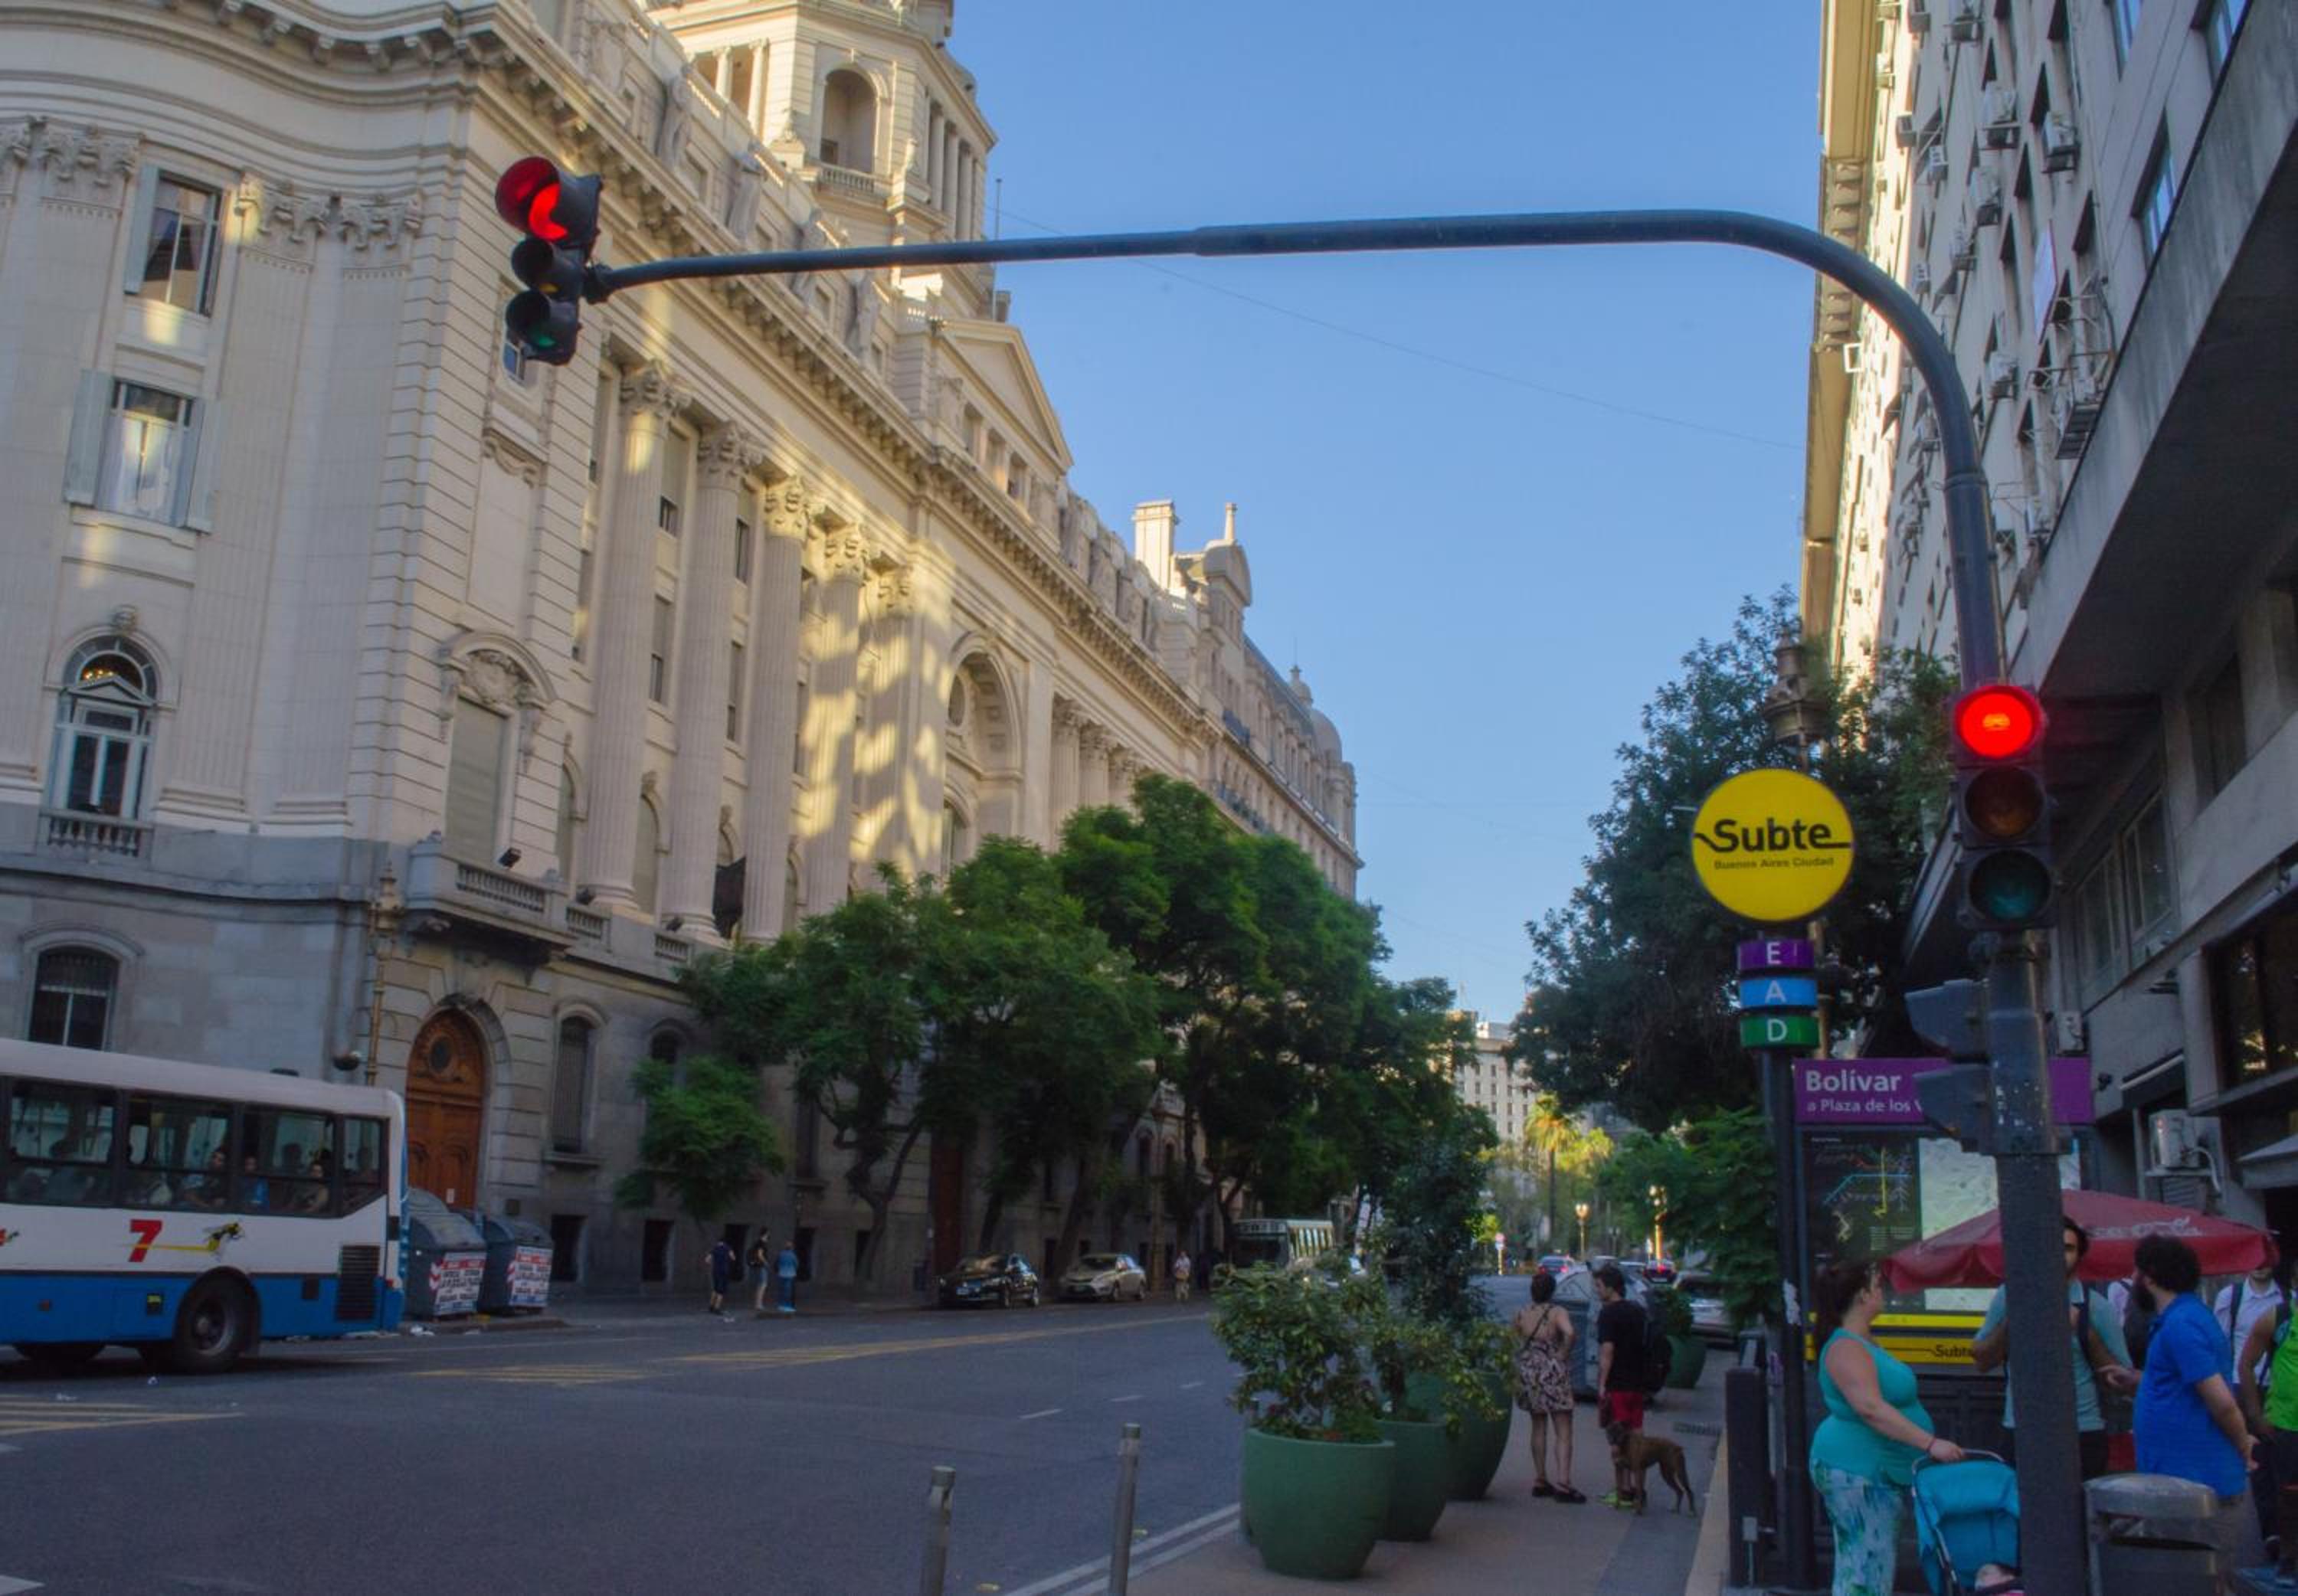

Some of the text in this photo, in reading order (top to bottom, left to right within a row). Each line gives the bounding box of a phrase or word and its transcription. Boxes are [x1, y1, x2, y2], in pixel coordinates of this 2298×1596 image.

[1708, 817, 1835, 853] Subte
[1714, 856, 1835, 870] Buenos Aires Ciudad
[1766, 941, 1782, 965] E
[1764, 980, 1787, 1004] A
[1767, 1018, 1789, 1042] D
[1805, 1069, 1903, 1092] Bolívar
[1806, 1101, 1817, 1113] a
[1819, 1097, 1861, 1113] Plaza
[1864, 1097, 1887, 1113] de
[1889, 1097, 1911, 1113] los
[128, 1219, 164, 1263] 7
